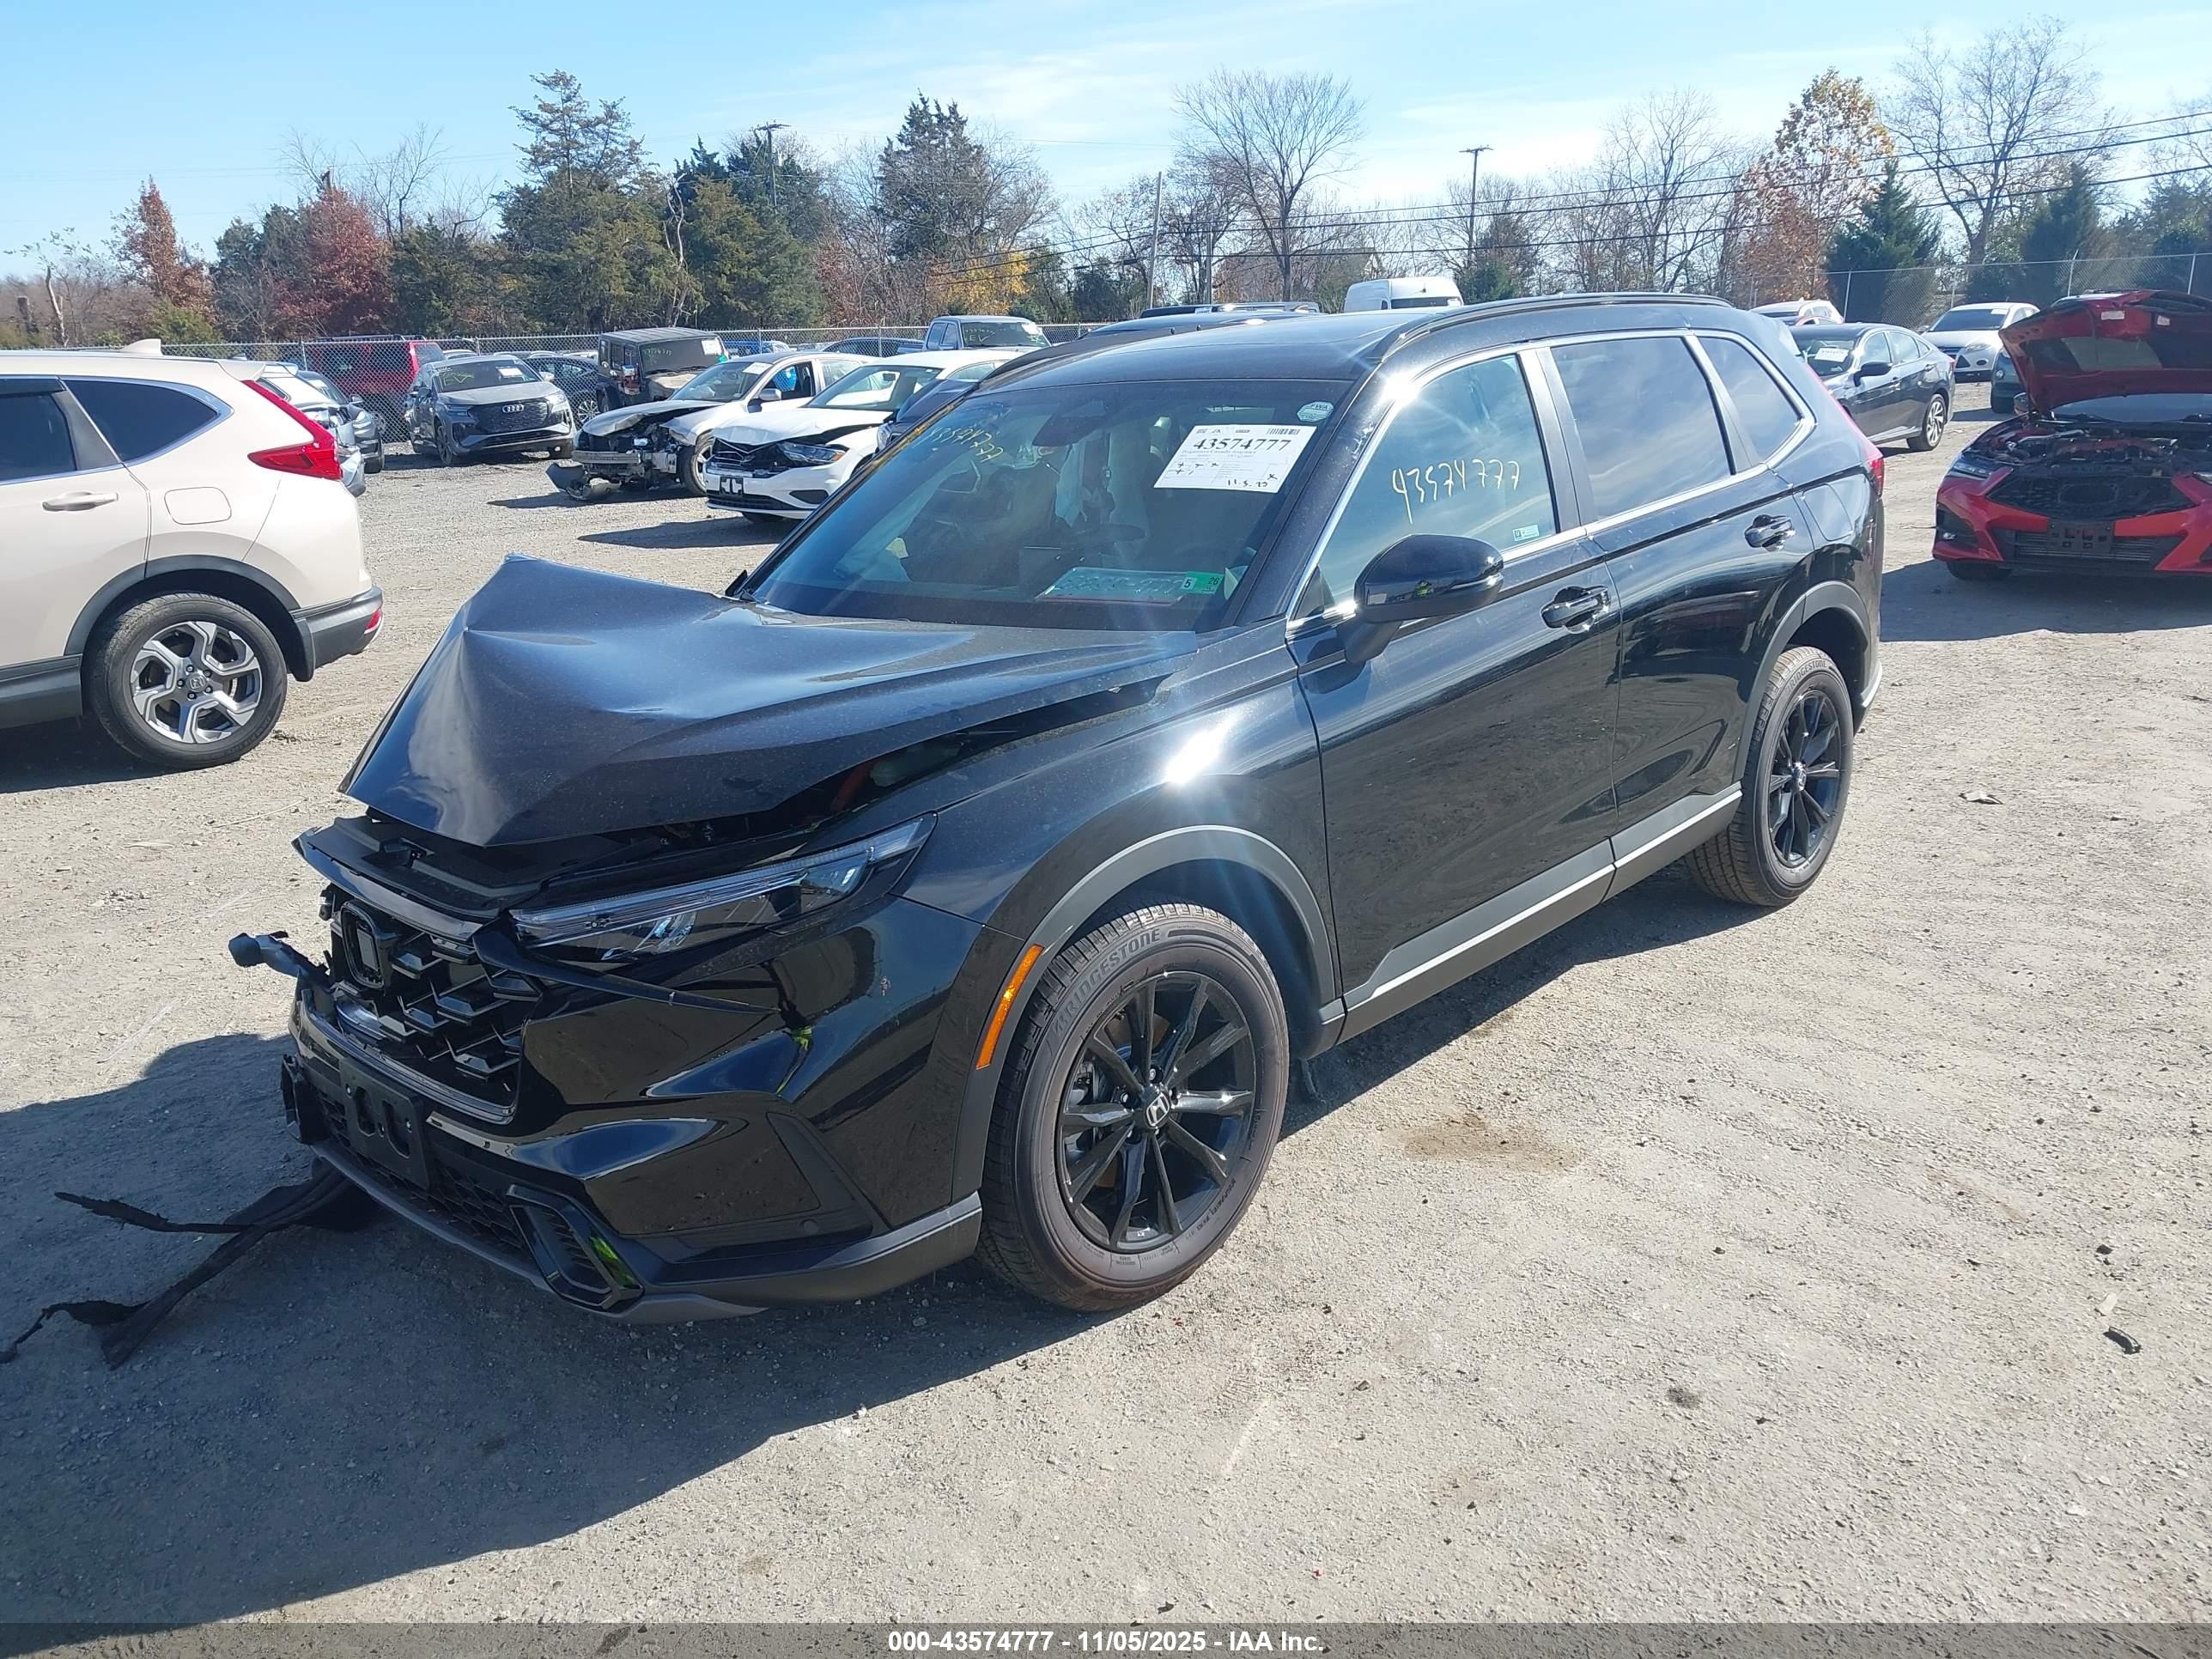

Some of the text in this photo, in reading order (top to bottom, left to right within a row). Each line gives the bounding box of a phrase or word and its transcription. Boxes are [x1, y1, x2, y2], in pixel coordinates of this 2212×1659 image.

[1194, 438, 1291, 452] 43574777
[1392, 459, 1520, 525] 43574777
[1183, 579, 1193, 588] 5
[1208, 576, 1220, 586] 26
[1053, 927, 1162, 1034] BRIDGESTONE
